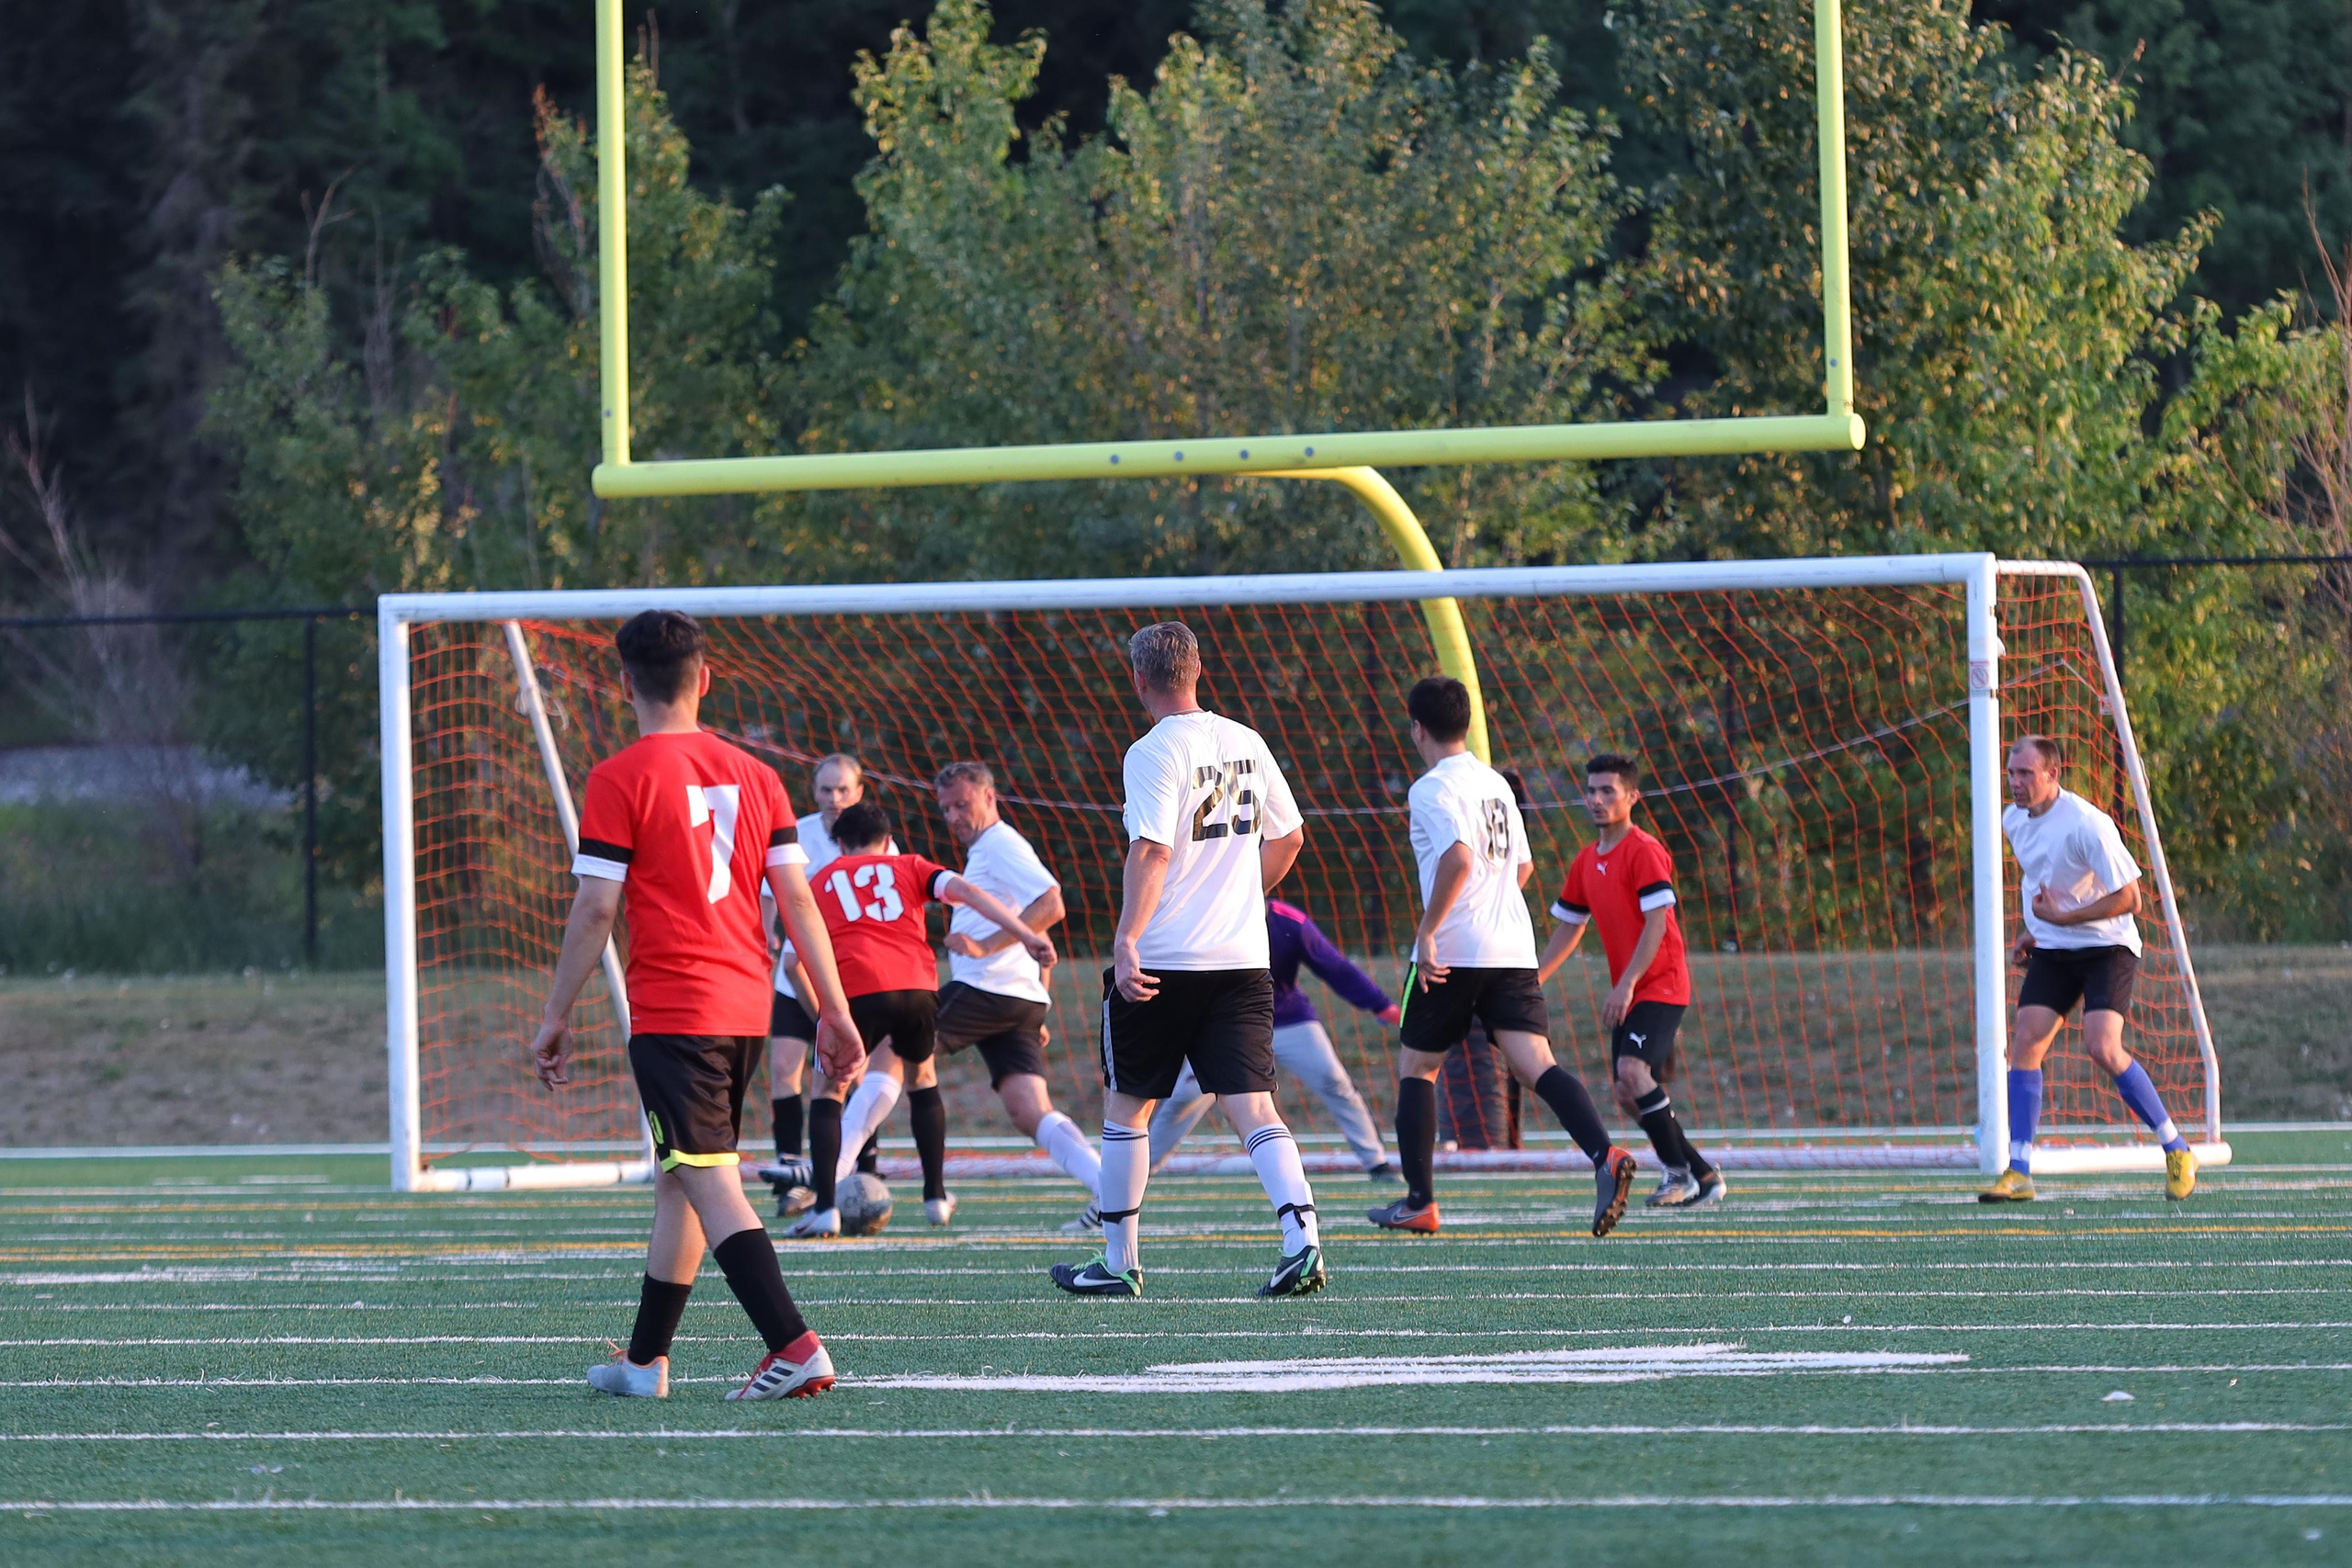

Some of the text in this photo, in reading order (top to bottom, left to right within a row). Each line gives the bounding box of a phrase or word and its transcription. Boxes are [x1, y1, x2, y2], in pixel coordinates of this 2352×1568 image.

[1192, 759, 1261, 842] 25
[684, 784, 741, 905] 7
[823, 862, 905, 923] 13
